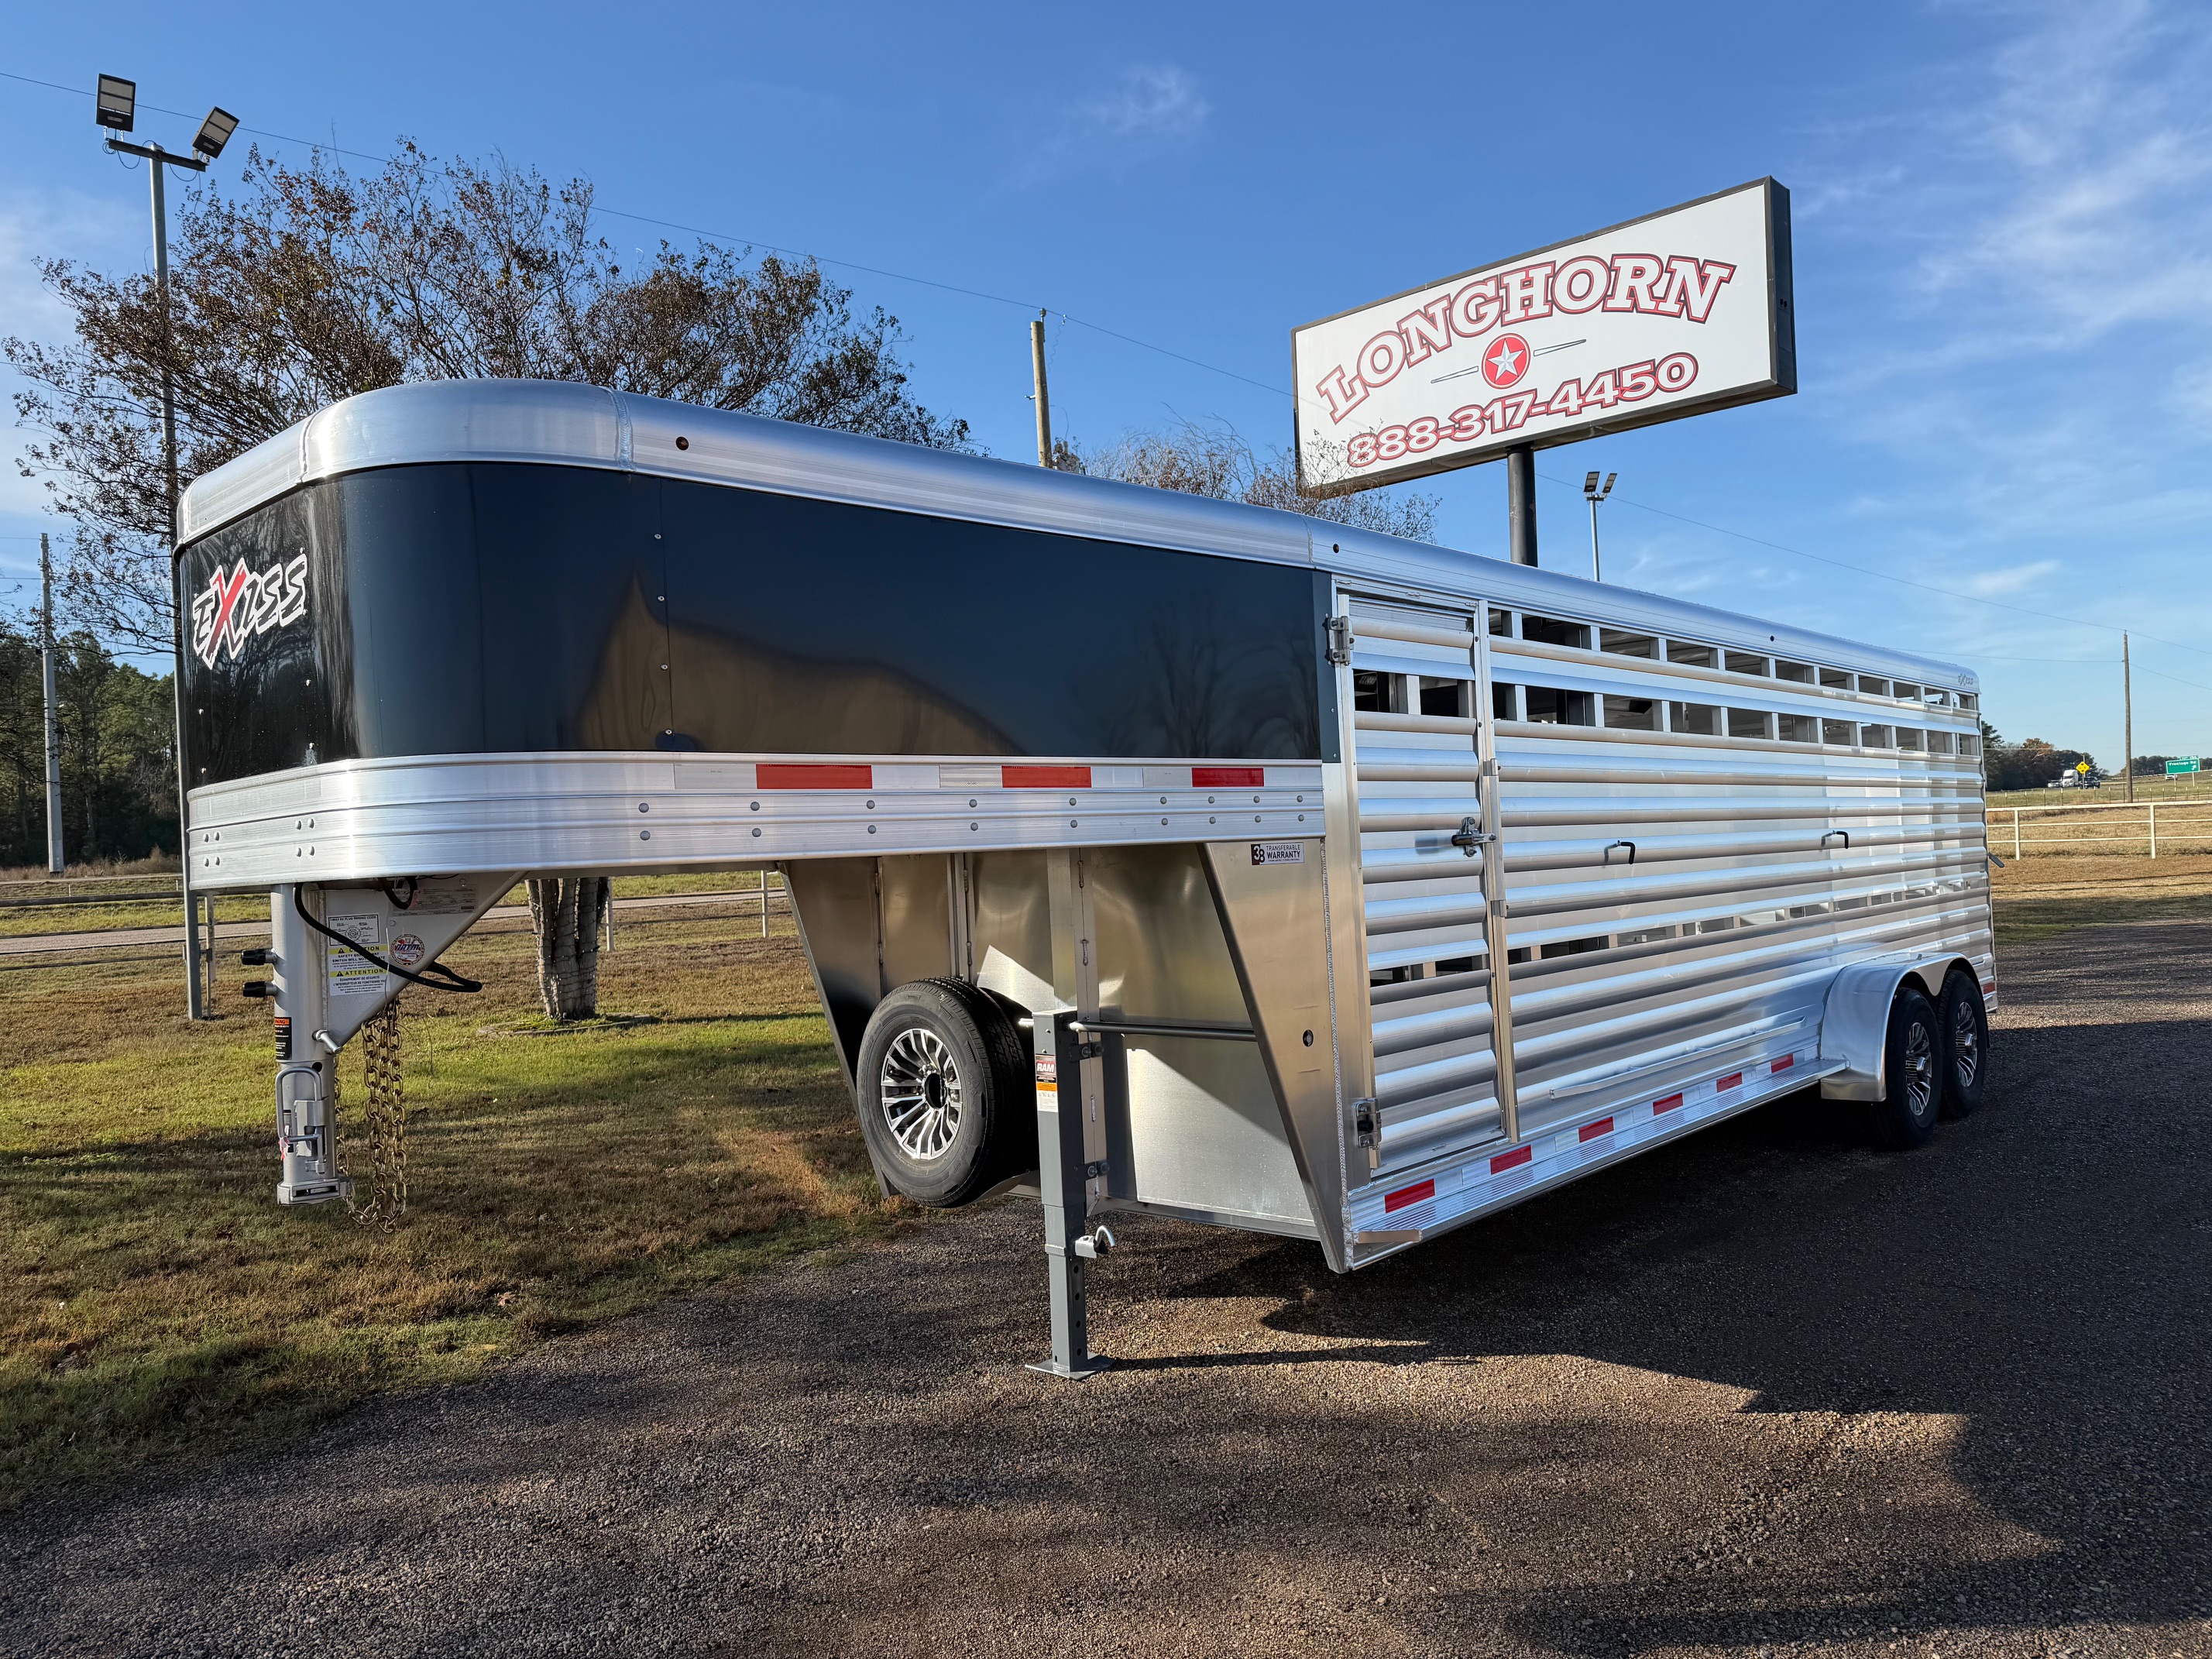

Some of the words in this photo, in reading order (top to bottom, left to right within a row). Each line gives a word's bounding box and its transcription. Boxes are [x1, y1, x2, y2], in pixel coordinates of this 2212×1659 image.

[1317, 253, 1736, 424] LONGHORN
[1347, 352, 1698, 468] 888-317-4450
[193, 554, 307, 670] EXISS
[1266, 850, 1301, 859] WARRANTY
[1036, 1063, 1055, 1073] RAM
